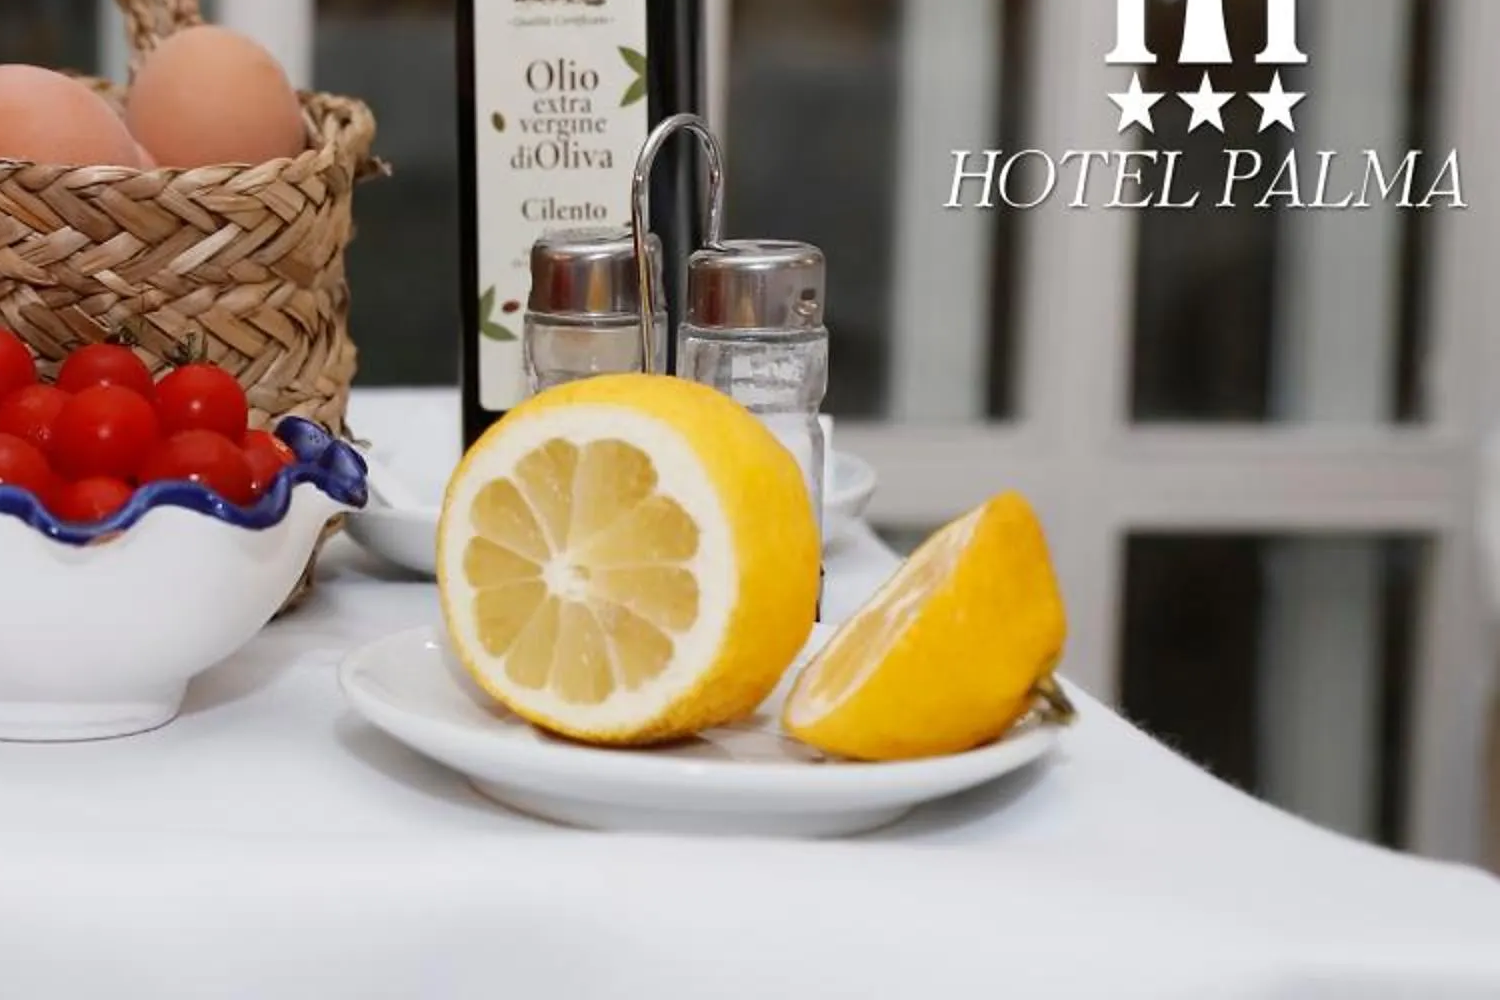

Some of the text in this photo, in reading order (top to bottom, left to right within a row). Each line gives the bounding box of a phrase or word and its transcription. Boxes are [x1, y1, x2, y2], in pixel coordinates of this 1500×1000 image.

[525, 58, 600, 93] Olio
[532, 94, 592, 114] extra
[519, 114, 607, 144] vergine
[521, 198, 608, 222] Cilento
